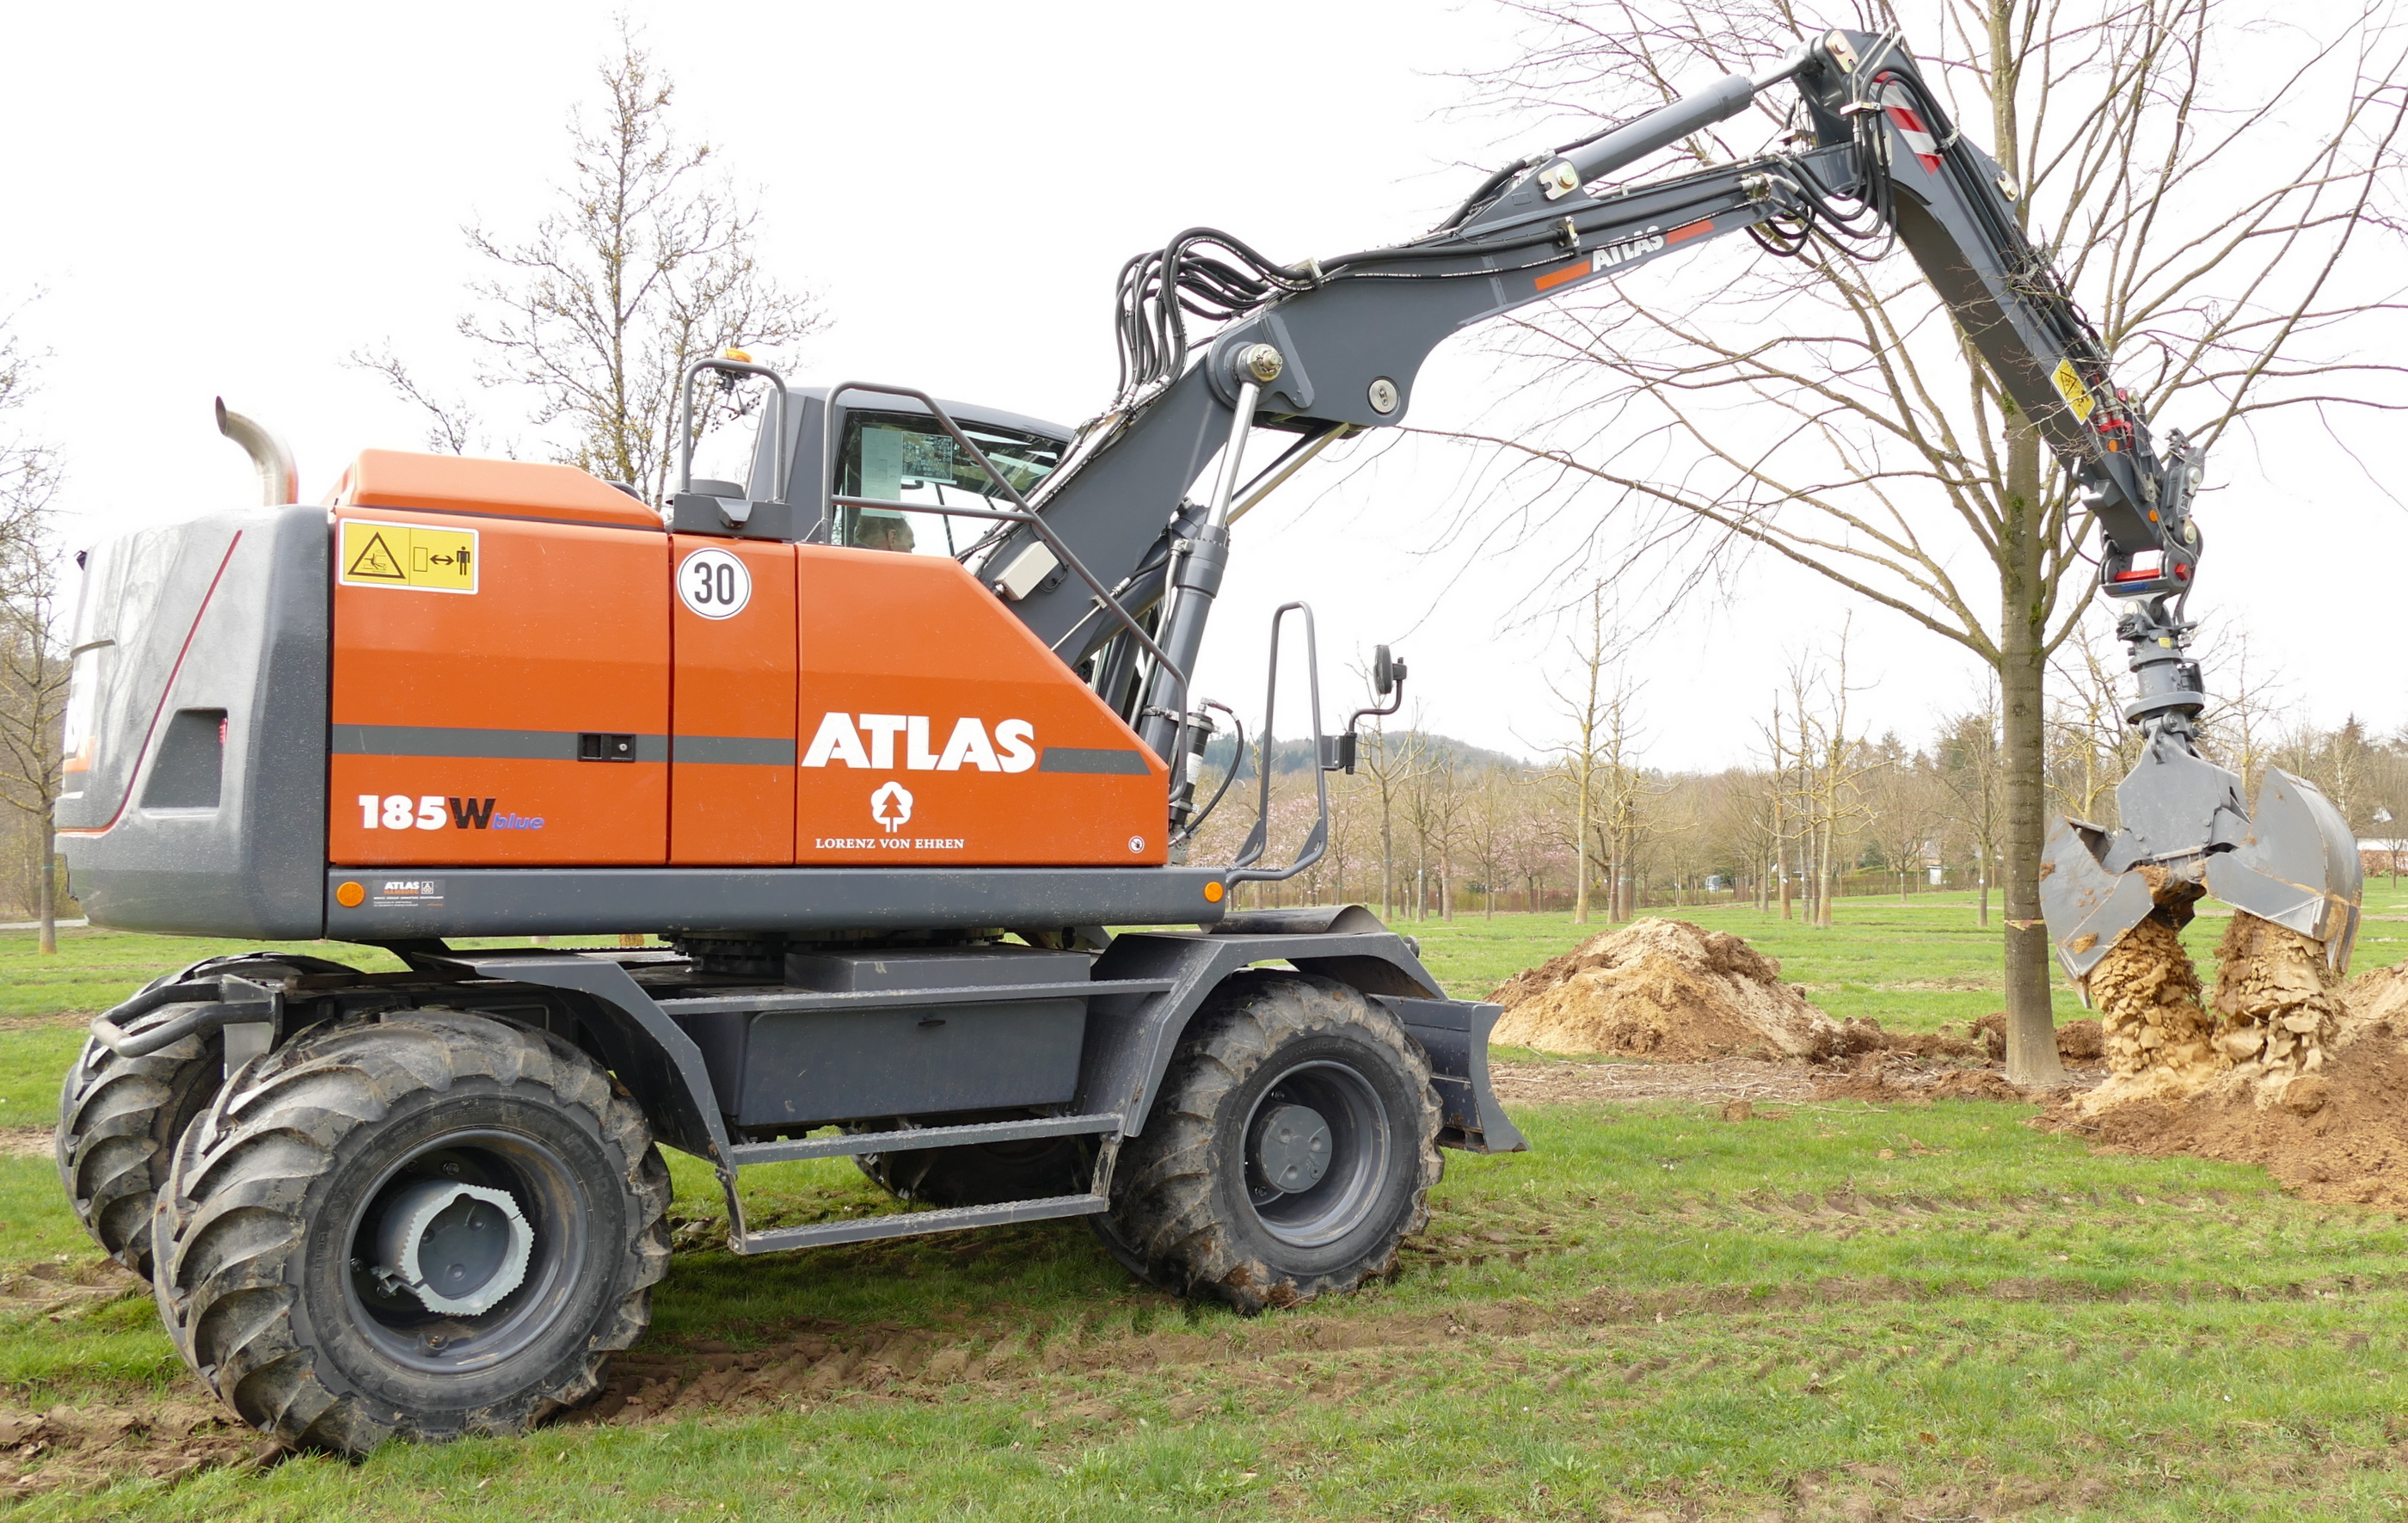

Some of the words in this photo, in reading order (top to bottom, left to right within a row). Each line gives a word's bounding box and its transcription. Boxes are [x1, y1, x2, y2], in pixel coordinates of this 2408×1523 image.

[1592, 224, 1665, 273] ATLAS
[693, 562, 735, 606] 30
[802, 711, 1037, 773] ATLAS
[815, 838, 875, 850] LORENZ
[880, 838, 912, 850] VON
[914, 838, 965, 850] EHREN
[384, 881, 421, 890] ATLAS
